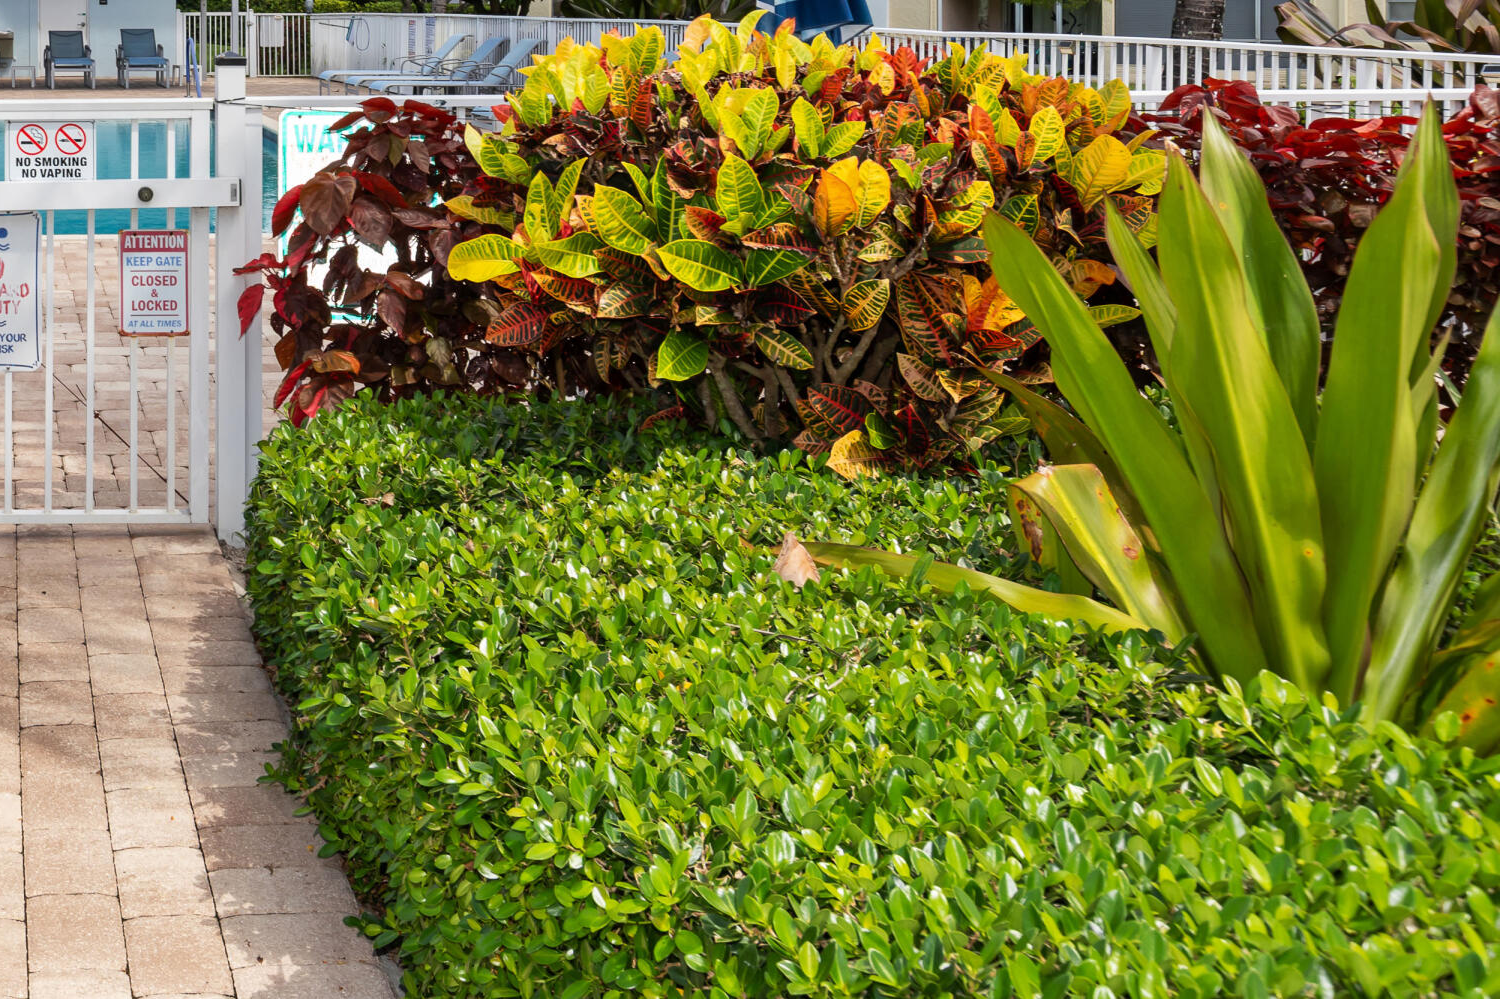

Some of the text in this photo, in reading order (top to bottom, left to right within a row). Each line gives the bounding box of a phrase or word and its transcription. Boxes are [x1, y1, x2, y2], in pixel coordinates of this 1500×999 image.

[16, 157, 87, 167] NO SMOKING
[21, 168, 82, 178] NO VAPING
[124, 235, 184, 249] ATTENTION
[126, 256, 182, 266] KEEP GATE
[131, 275, 178, 287] CLOSED
[150, 288, 159, 298] &
[131, 300, 178, 311] LOCKED
[128, 320, 182, 328] AT ALL TIMES
[0, 333, 27, 343] YOUR
